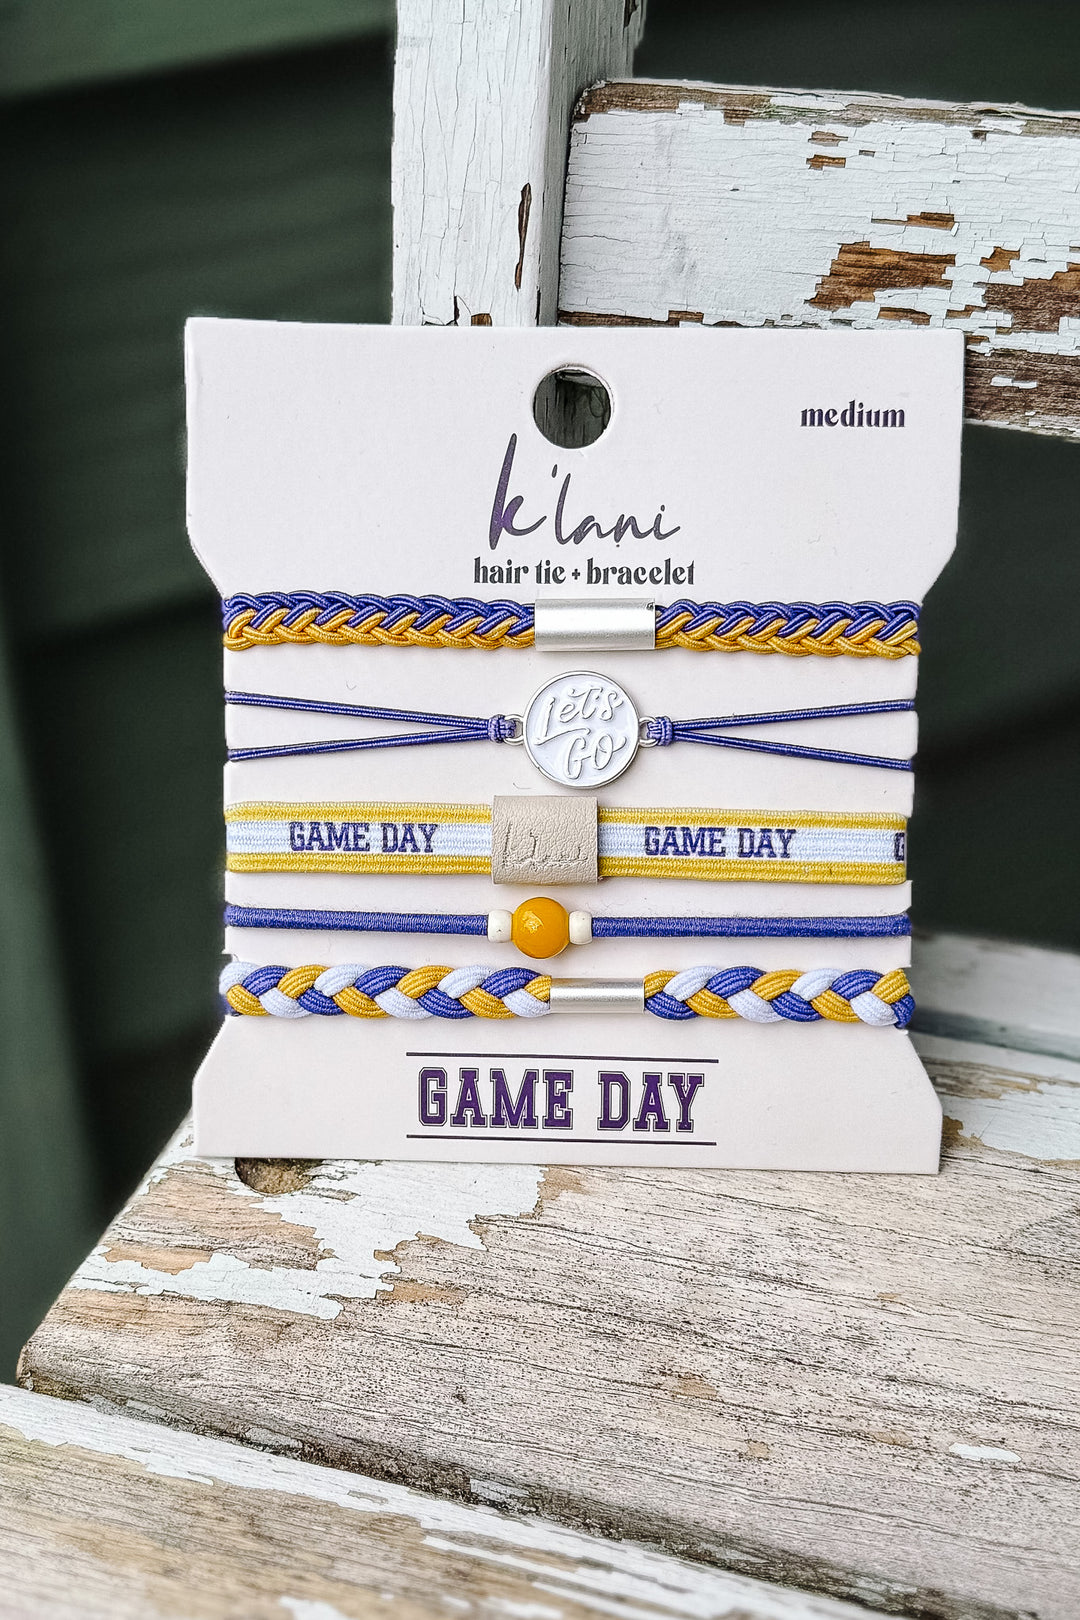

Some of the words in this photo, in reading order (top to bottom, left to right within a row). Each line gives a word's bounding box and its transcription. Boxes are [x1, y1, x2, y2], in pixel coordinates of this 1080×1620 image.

[800, 400, 906, 428] medium
[474, 556, 529, 584] hair
[536, 559, 566, 585] tie
[586, 557, 695, 585] bracelet
[288, 820, 371, 852] GAME
[381, 822, 438, 853] DAY
[644, 825, 727, 857] GAME
[736, 827, 797, 859] DAY
[418, 1066, 574, 1130] GAME
[597, 1070, 705, 1133] DAY
